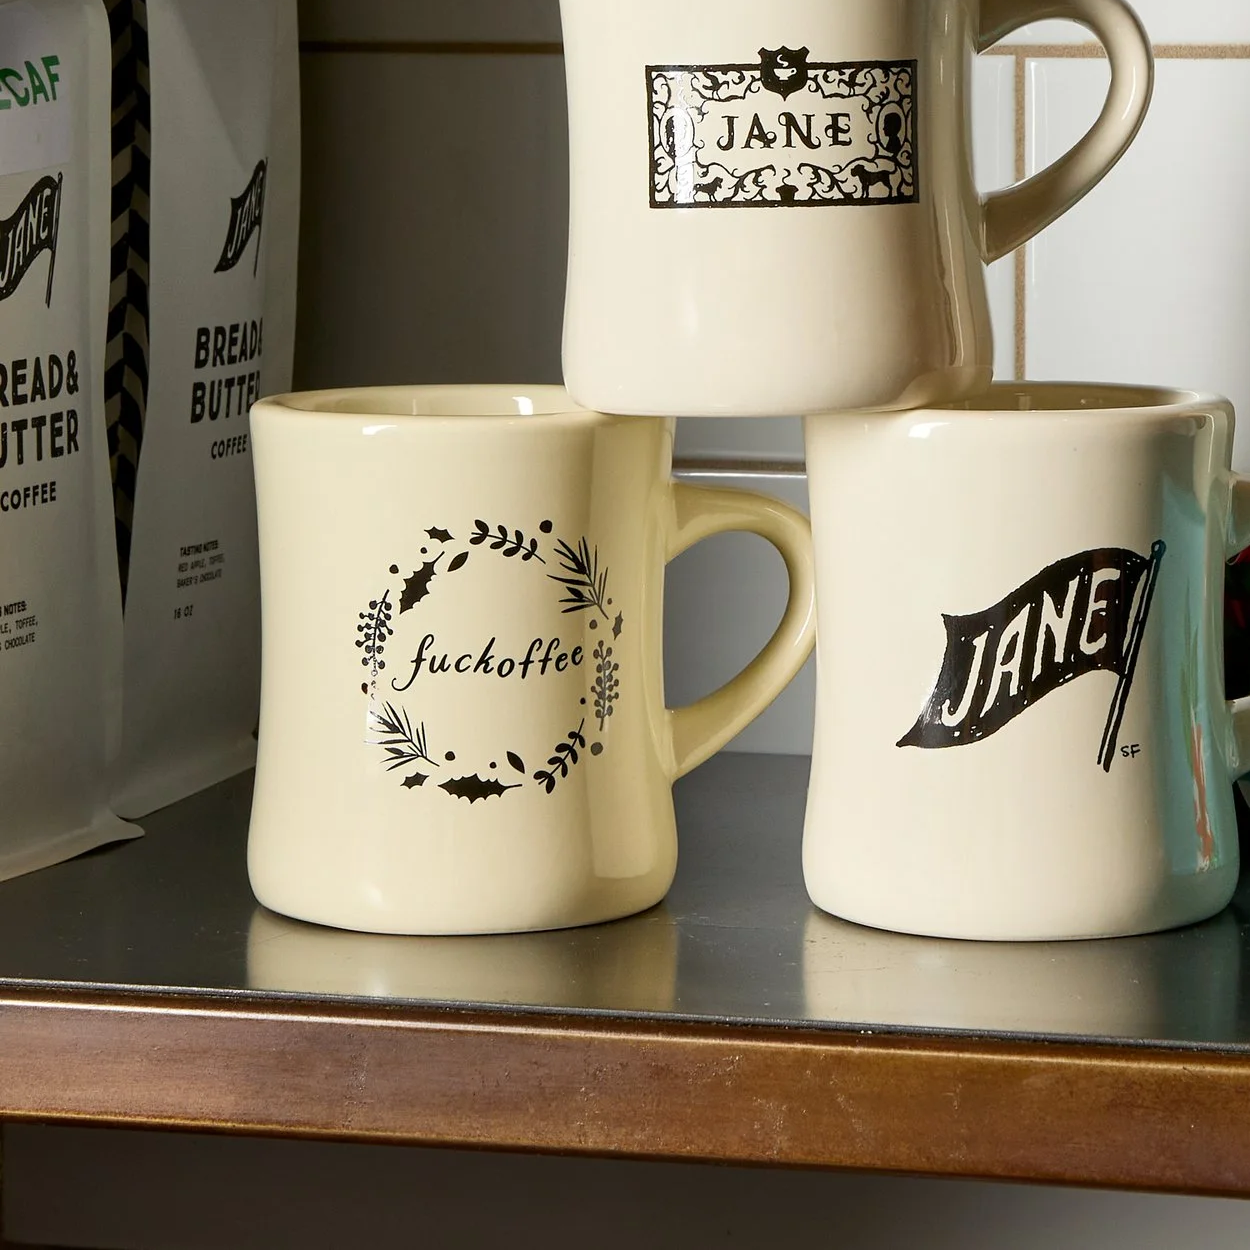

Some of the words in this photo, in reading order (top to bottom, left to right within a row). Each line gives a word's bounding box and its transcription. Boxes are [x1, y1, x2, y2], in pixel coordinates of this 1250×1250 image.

[715, 111, 853, 151] JANE
[226, 170, 263, 258] JANE
[0, 187, 51, 288] JANE
[211, 434, 248, 460] COFFEE
[0, 481, 57, 512] COFFEE
[184, 604, 194, 618] OZ
[4, 632, 36, 651] CHOCOLATE
[941, 567, 1121, 727] JANE
[391, 633, 585, 692] fuckoffee
[1120, 743, 1142, 759] SF
